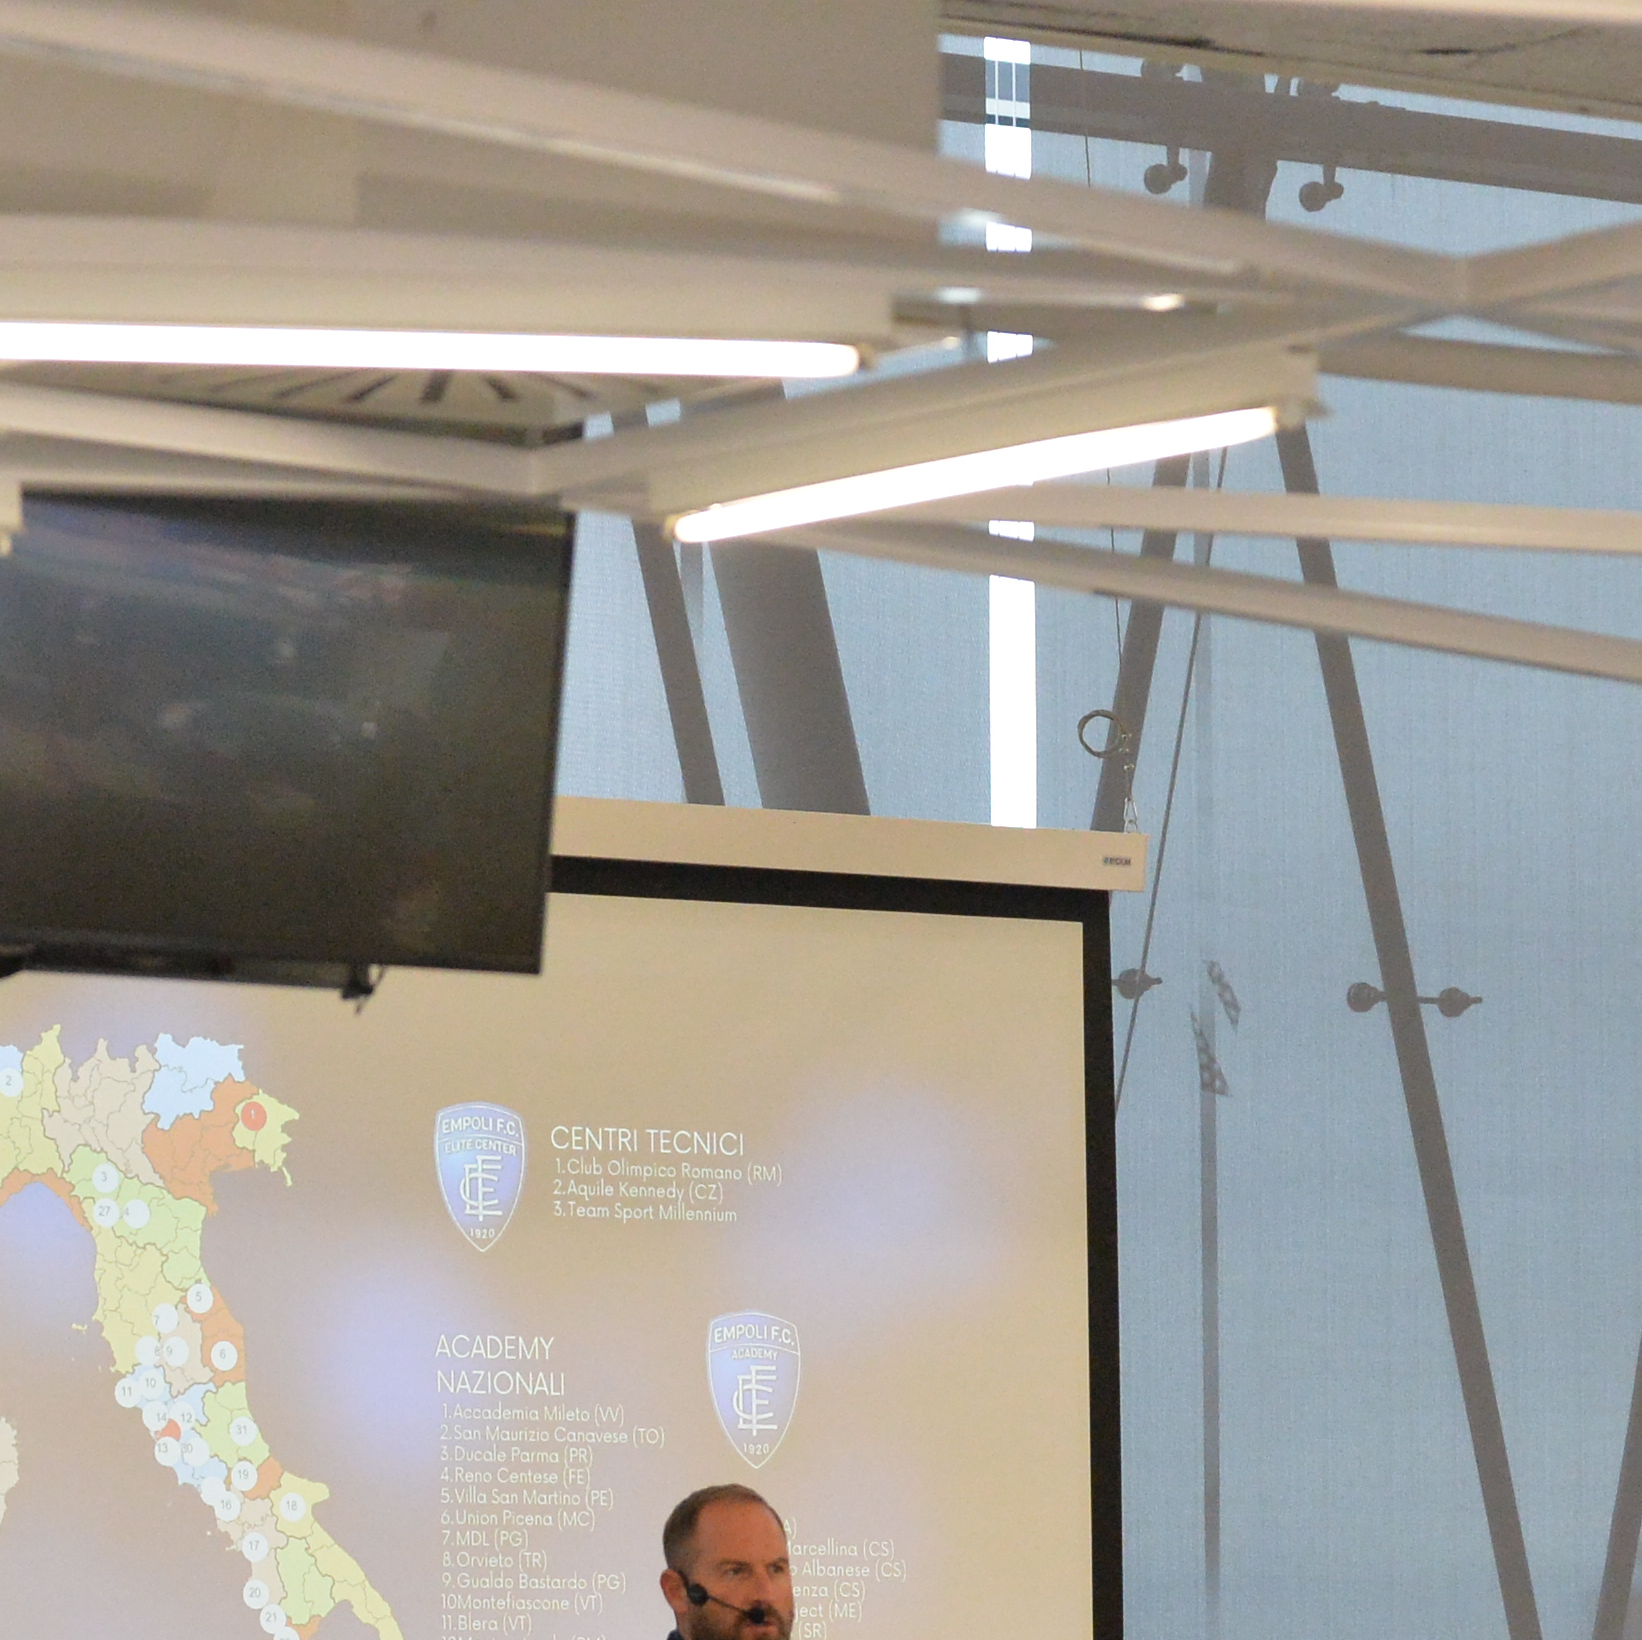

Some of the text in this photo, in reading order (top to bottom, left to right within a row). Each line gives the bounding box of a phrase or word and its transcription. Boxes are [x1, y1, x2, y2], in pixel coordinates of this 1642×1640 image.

[5, 1075, 12, 1086] 2
[441, 1116, 519, 1137] EMPOLI F.C.
[445, 1140, 517, 1157] ELITE CENTER
[550, 1125, 744, 1156] CENTRI TECNICI
[100, 1172, 108, 1182] 3
[607, 1160, 782, 1186] Olimpico Romano (RM)
[618, 1182, 684, 1203] Kennedy
[689, 1182, 723, 1204] (CZ)
[99, 1206, 111, 1216] 27
[614, 1203, 737, 1224] Sport Millennium
[469, 1228, 496, 1240] 1920
[195, 1291, 202, 1302] 5
[714, 1324, 795, 1346] EMPOLI F.C.
[219, 1349, 226, 1359] 6
[435, 1334, 554, 1360] ACADEMY
[731, 1348, 778, 1361] ACADEMY
[121, 1386, 132, 1396] 11
[145, 1378, 157, 1388] 10
[437, 1370, 565, 1396] NAZIONALI
[157, 1412, 167, 1423] 14
[181, 1413, 193, 1423] 12
[544, 1405, 590, 1423] Mileto
[235, 1425, 247, 1435] 31
[486, 1425, 664, 1449] Maurizio Canavese (TO)
[511, 1446, 559, 1463] Parma
[564, 1445, 593, 1469] (PR)
[743, 1443, 770, 1455] 1920
[238, 1469, 249, 1480] 19
[497, 1466, 591, 1489] Centese (FE)
[221, 1500, 232, 1510] 16
[286, 1500, 297, 1511] 18
[492, 1487, 613, 1510] San Martino (PE)
[503, 1508, 595, 1532] Picena (MC)
[249, 1540, 260, 1551] 17
[494, 1529, 528, 1551] (PG)
[863, 1539, 894, 1561] (CS)
[518, 1550, 547, 1573] (TR)
[802, 1559, 870, 1576] Albanese
[875, 1560, 907, 1582] (CS)
[249, 1587, 261, 1599] 20
[519, 1571, 626, 1595] Bastardo (PG)
[834, 1580, 865, 1602] (CS)
[574, 1593, 604, 1615] (VT)
[829, 1600, 861, 1622] (ME)
[266, 1612, 277, 1623] 21
[503, 1614, 532, 1635] (VT)
